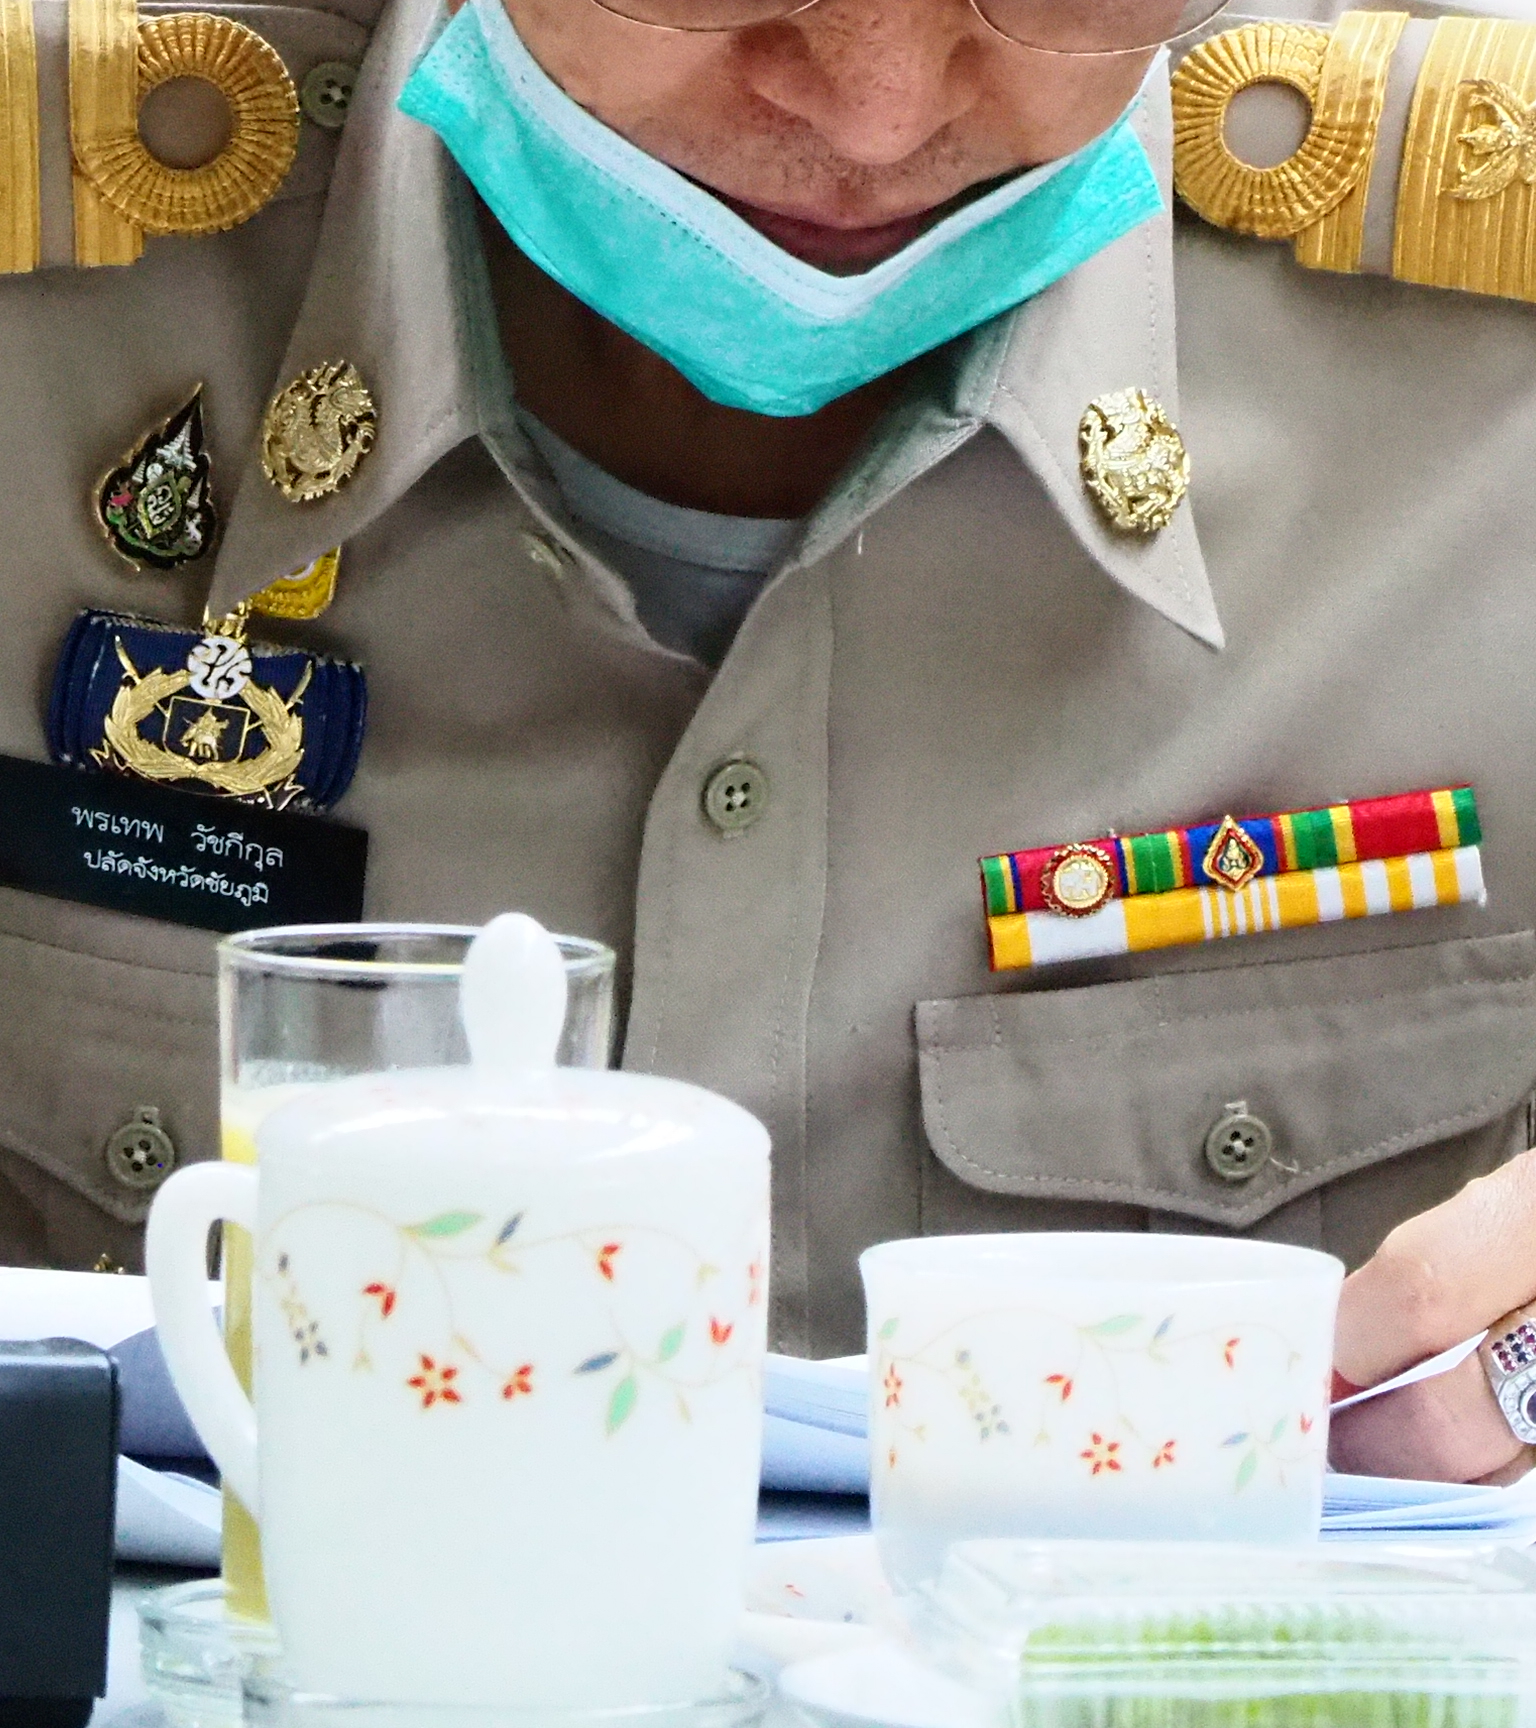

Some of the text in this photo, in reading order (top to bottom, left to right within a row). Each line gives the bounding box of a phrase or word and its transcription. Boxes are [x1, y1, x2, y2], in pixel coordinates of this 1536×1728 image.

[71, 805, 164, 844] พรเทพ
[83, 849, 270, 907] ปลัดจังหวัดชัยภูมิ
